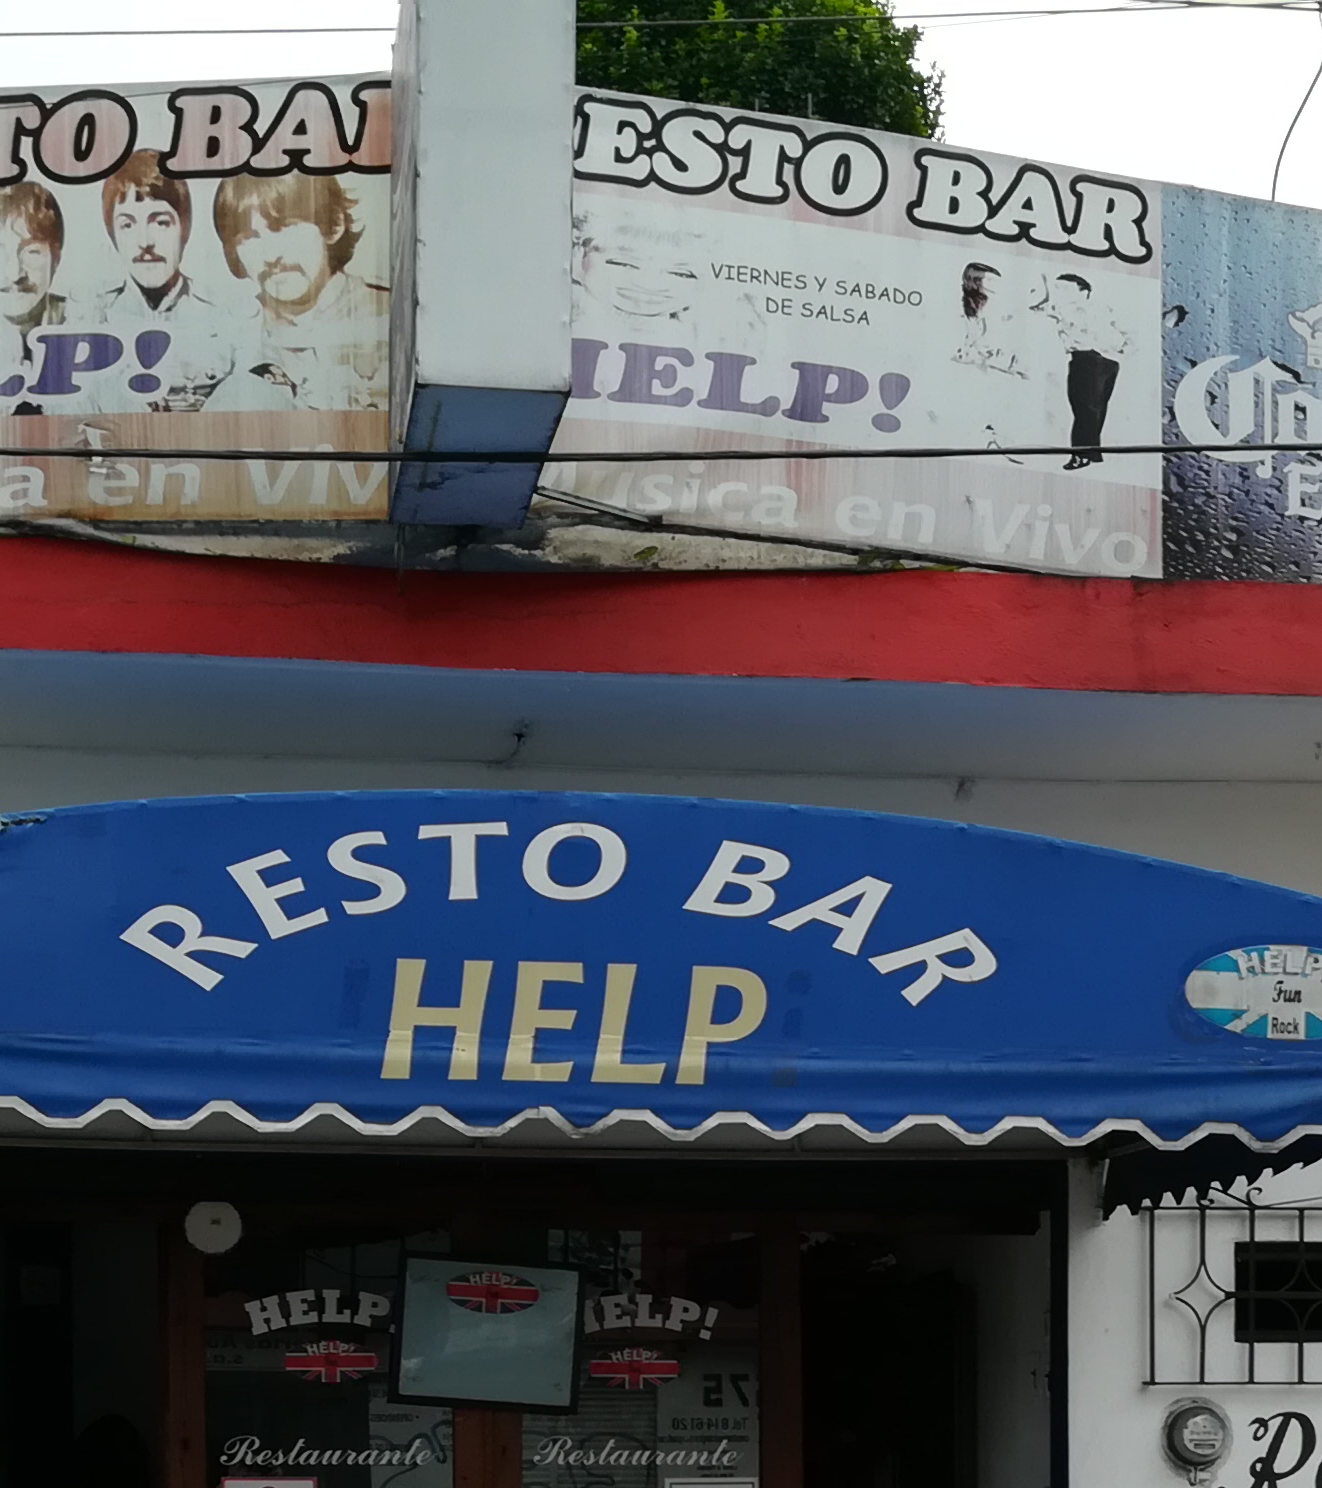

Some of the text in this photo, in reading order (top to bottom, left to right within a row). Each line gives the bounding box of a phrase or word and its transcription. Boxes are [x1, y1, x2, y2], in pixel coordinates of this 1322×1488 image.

[573, 94, 1154, 265] ESTO BAR
[711, 262, 923, 307] VIERNES Y SABADO
[765, 296, 870, 326] DE SALSA
[241, 444, 389, 505] Viv
[834, 496, 937, 544] en
[980, 496, 1148, 573] Vivo
[119, 821, 998, 1007] RESTO BAR
[1271, 980, 1303, 1004] Fun
[380, 958, 767, 1086] HELP
[1271, 1016, 1300, 1035] Rock
[219, 1434, 437, 1466] Restaurante
[532, 1435, 744, 1466] Restaurante
